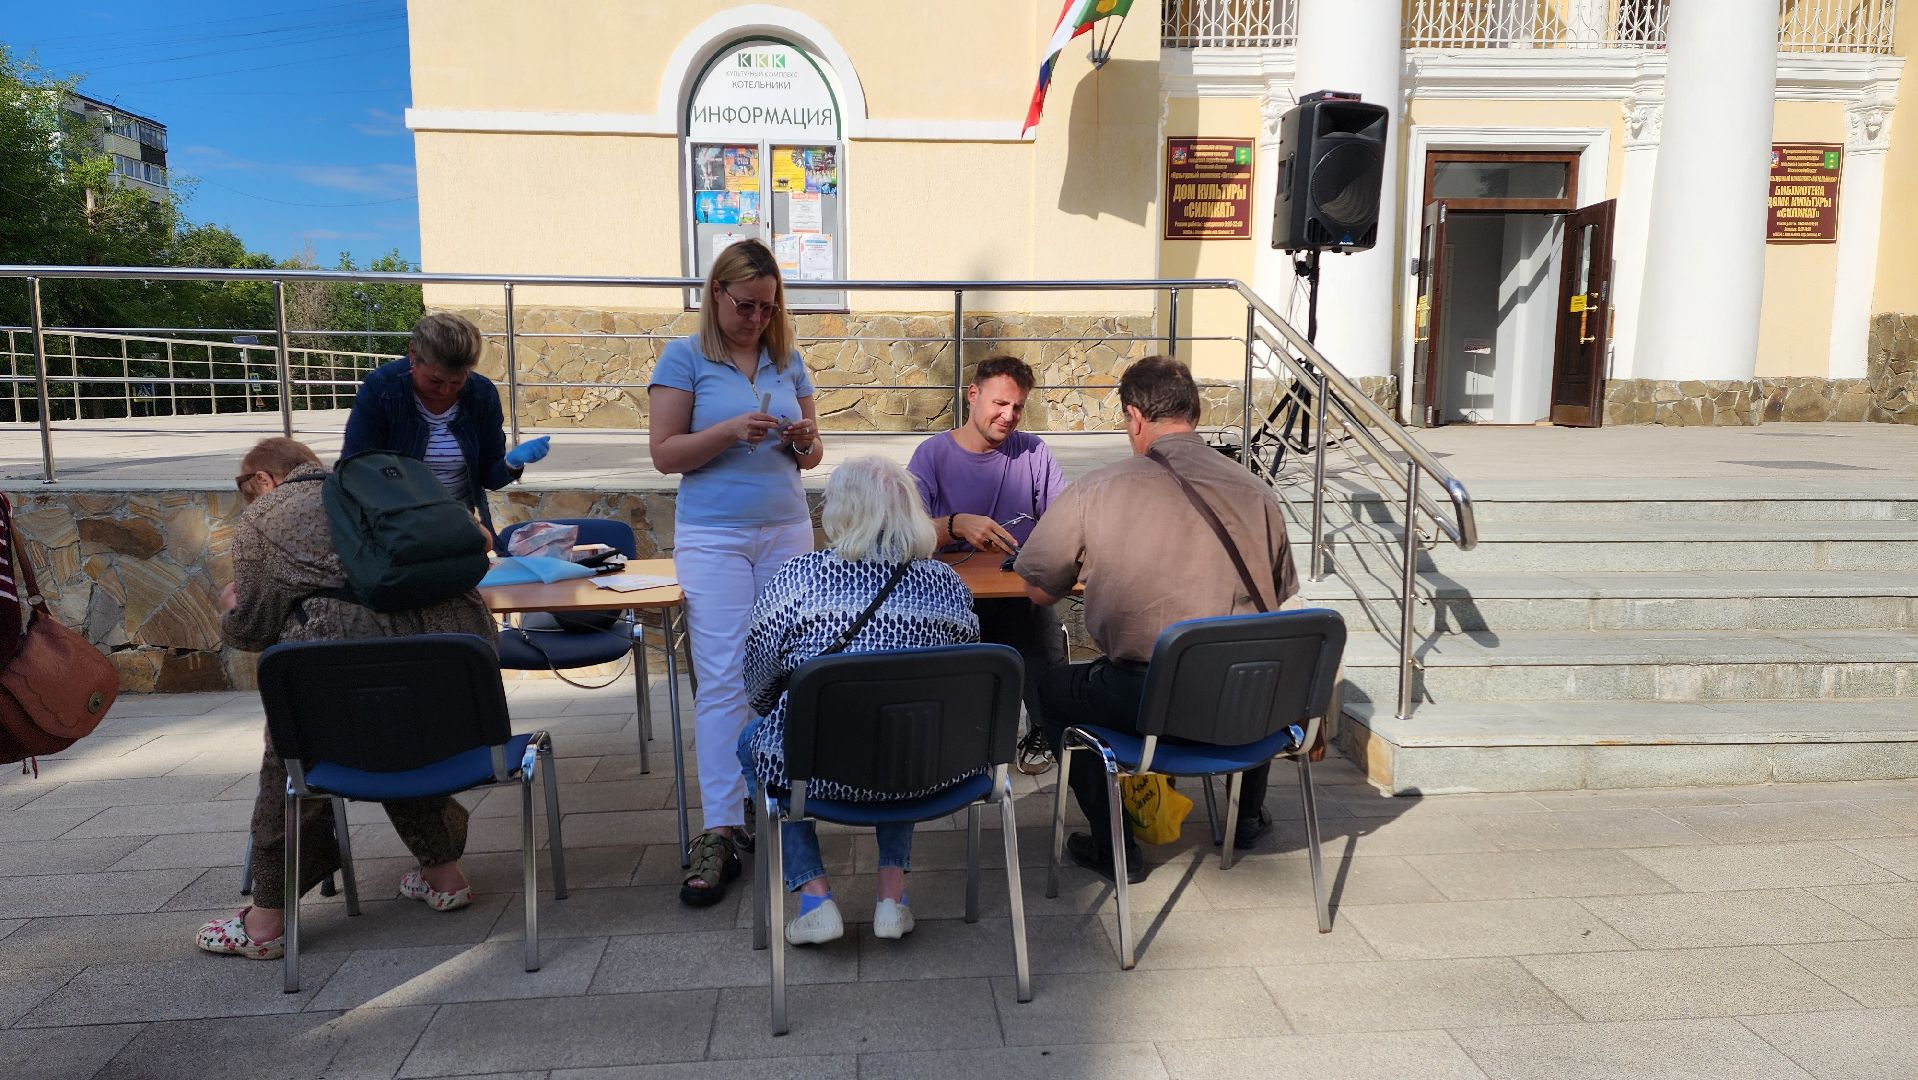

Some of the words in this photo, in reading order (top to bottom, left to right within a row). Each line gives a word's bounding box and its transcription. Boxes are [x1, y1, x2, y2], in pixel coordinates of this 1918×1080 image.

[732, 80, 791, 90] КОТЕЛЬНИКИ
[693, 106, 833, 129] ИНФОРМАЦИЯ
[1173, 184, 1195, 202] ДОМ
[1197, 184, 1247, 200] КУЛЬТУРЫ
[1775, 185, 1825, 196] БИБЛИОТЕКА
[1791, 197, 1832, 208] КУЛЬТУРЫ
[1184, 202, 1235, 218] «СИЛИКАТ»
